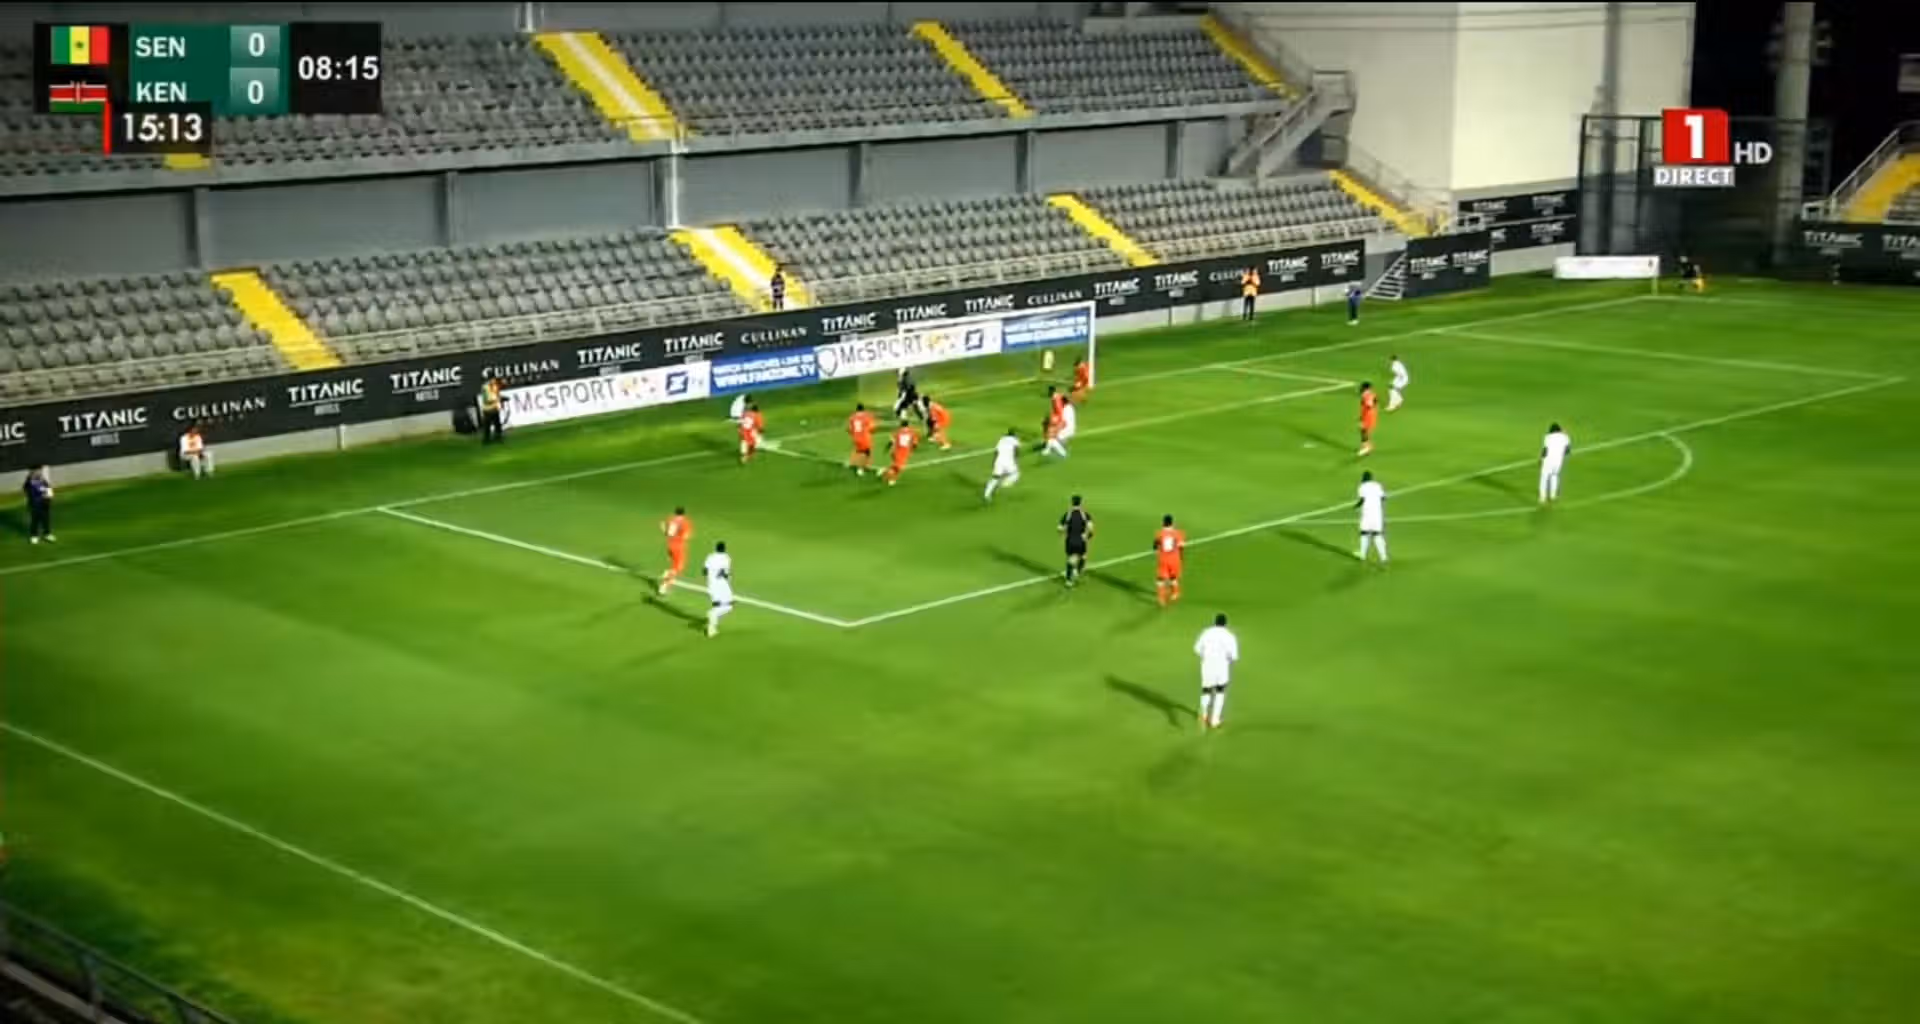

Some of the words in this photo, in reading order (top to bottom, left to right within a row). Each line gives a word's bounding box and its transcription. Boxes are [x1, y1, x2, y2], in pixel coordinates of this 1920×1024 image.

[1882, 234, 1920, 249] TITA
[894, 304, 947, 321] TITANIC
[965, 294, 1014, 312] TITANIC
[822, 312, 876, 331] TITANIC
[664, 332, 724, 353] TITANIC
[577, 343, 641, 364] TITANIC
[389, 366, 462, 389] TITANIC
[482, 359, 560, 378] CULLINAN
[288, 379, 364, 402] TITANIC
[512, 378, 615, 413] McSPORT
[173, 397, 266, 420] CULLINAN
[58, 407, 147, 432] TITANIC
[0, 422, 25, 440] IC
